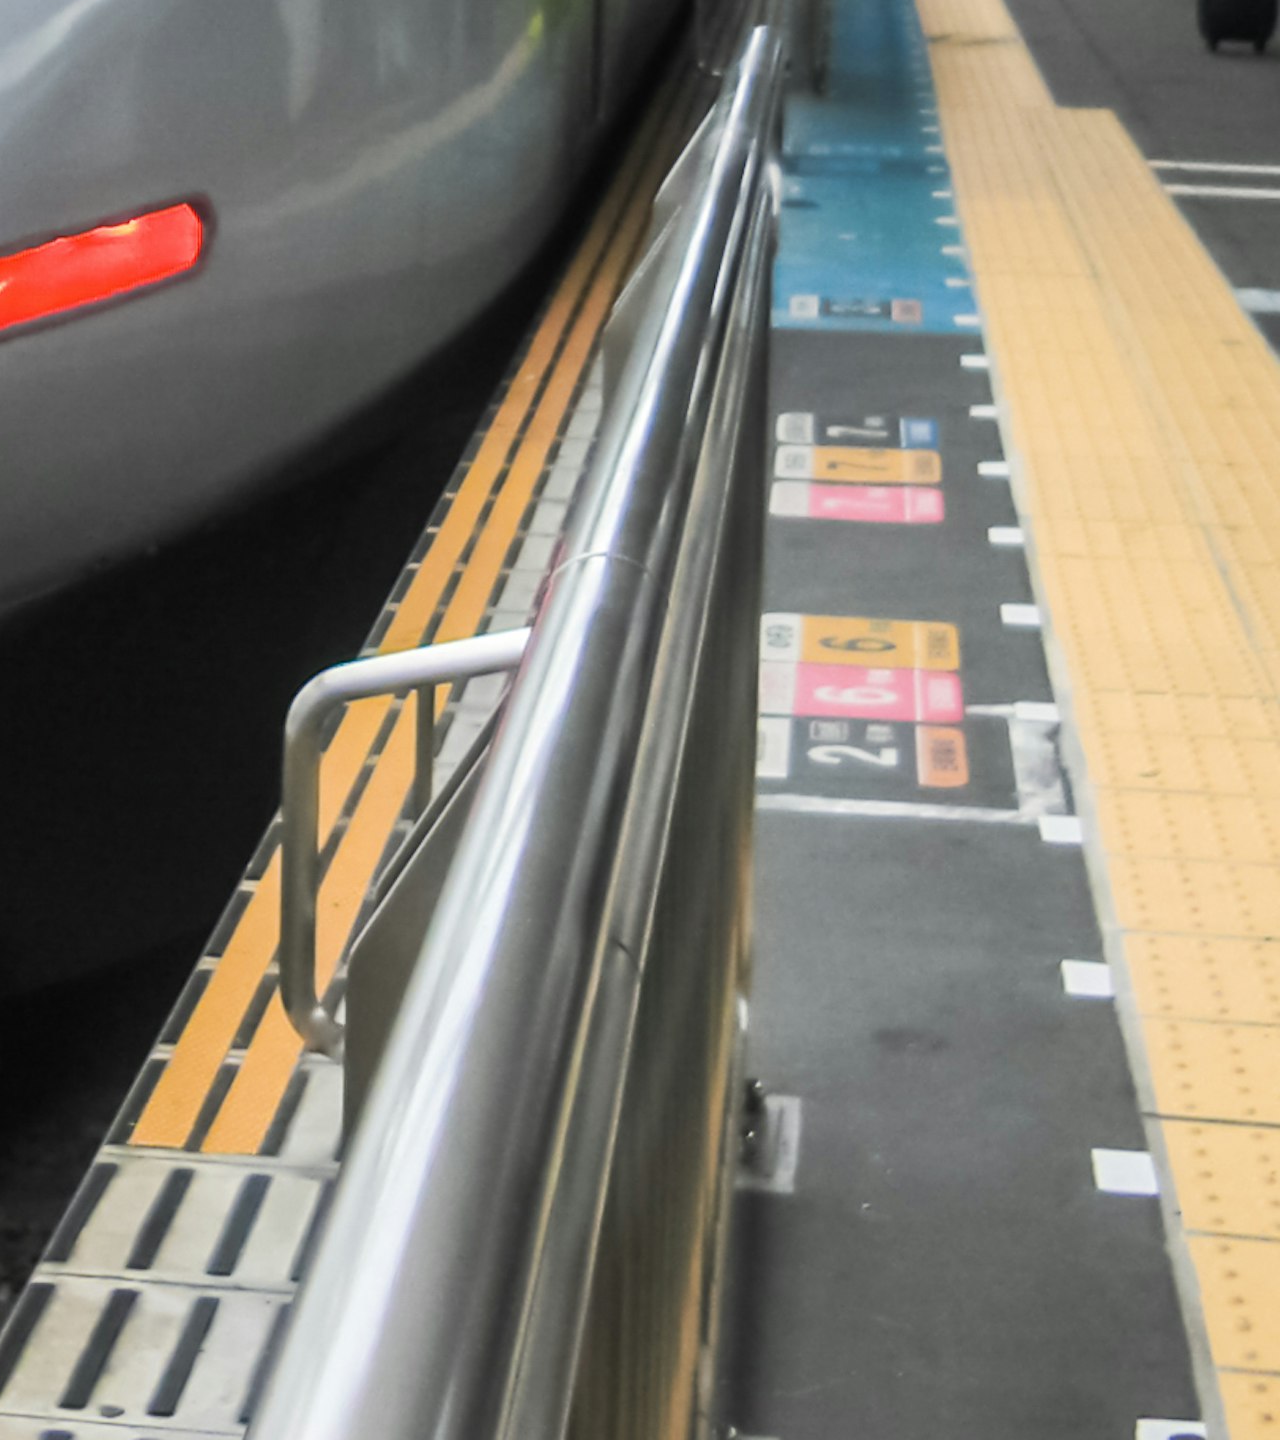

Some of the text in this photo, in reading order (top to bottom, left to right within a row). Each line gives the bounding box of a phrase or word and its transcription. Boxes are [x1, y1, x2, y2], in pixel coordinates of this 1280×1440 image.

[819, 636, 897, 652] 6
[814, 685, 898, 705] 6
[807, 744, 898, 766] 2
